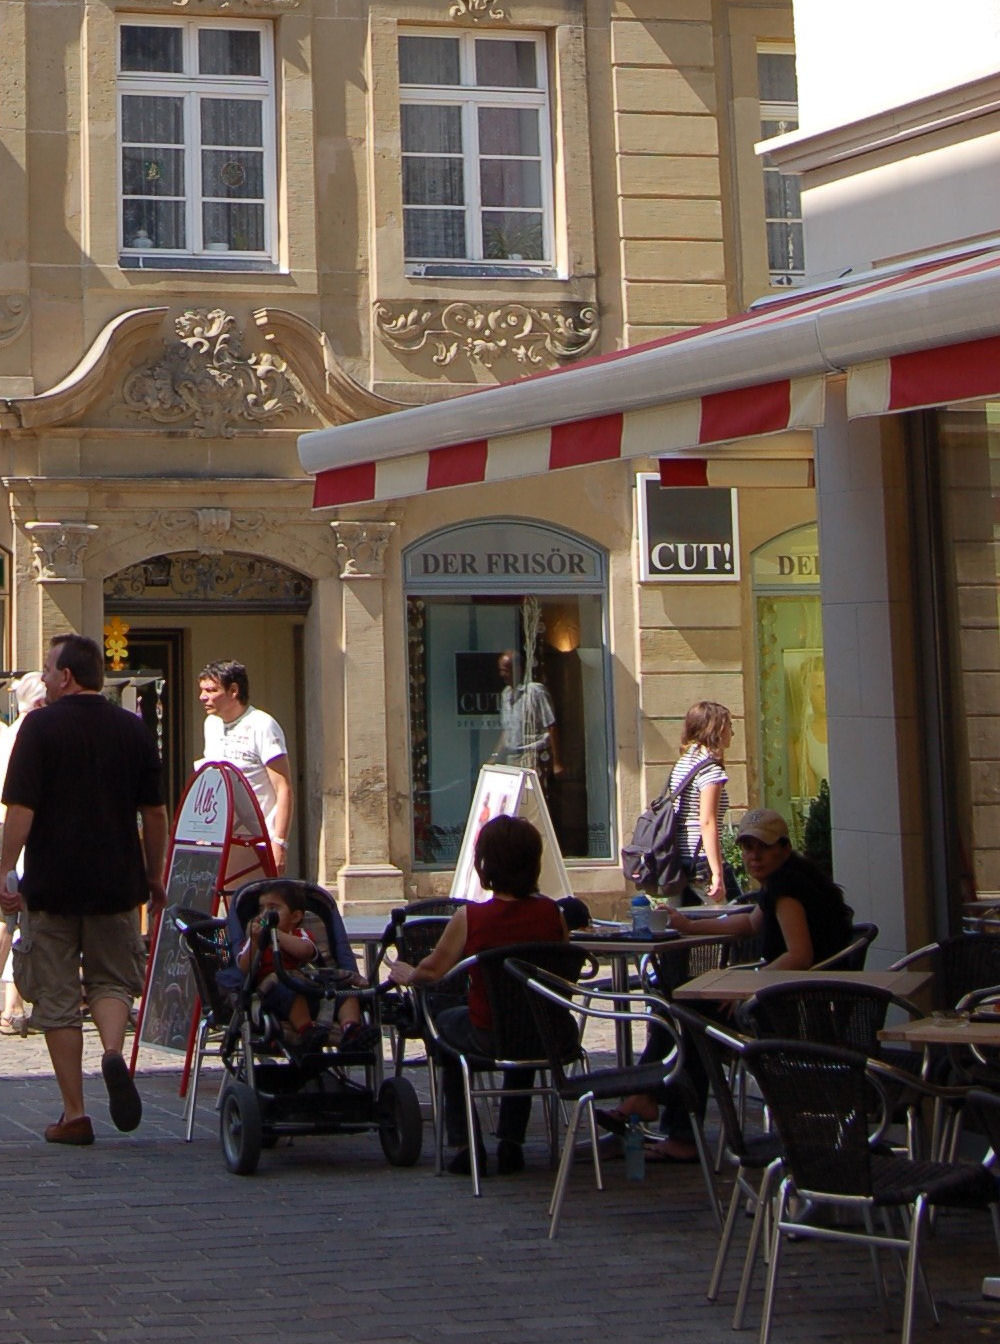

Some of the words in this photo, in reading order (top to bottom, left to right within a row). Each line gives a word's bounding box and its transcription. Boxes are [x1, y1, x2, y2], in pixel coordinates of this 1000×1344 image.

[422, 553, 479, 574] DER
[485, 548, 586, 574] FRISÖR
[651, 542, 731, 571] CUT!
